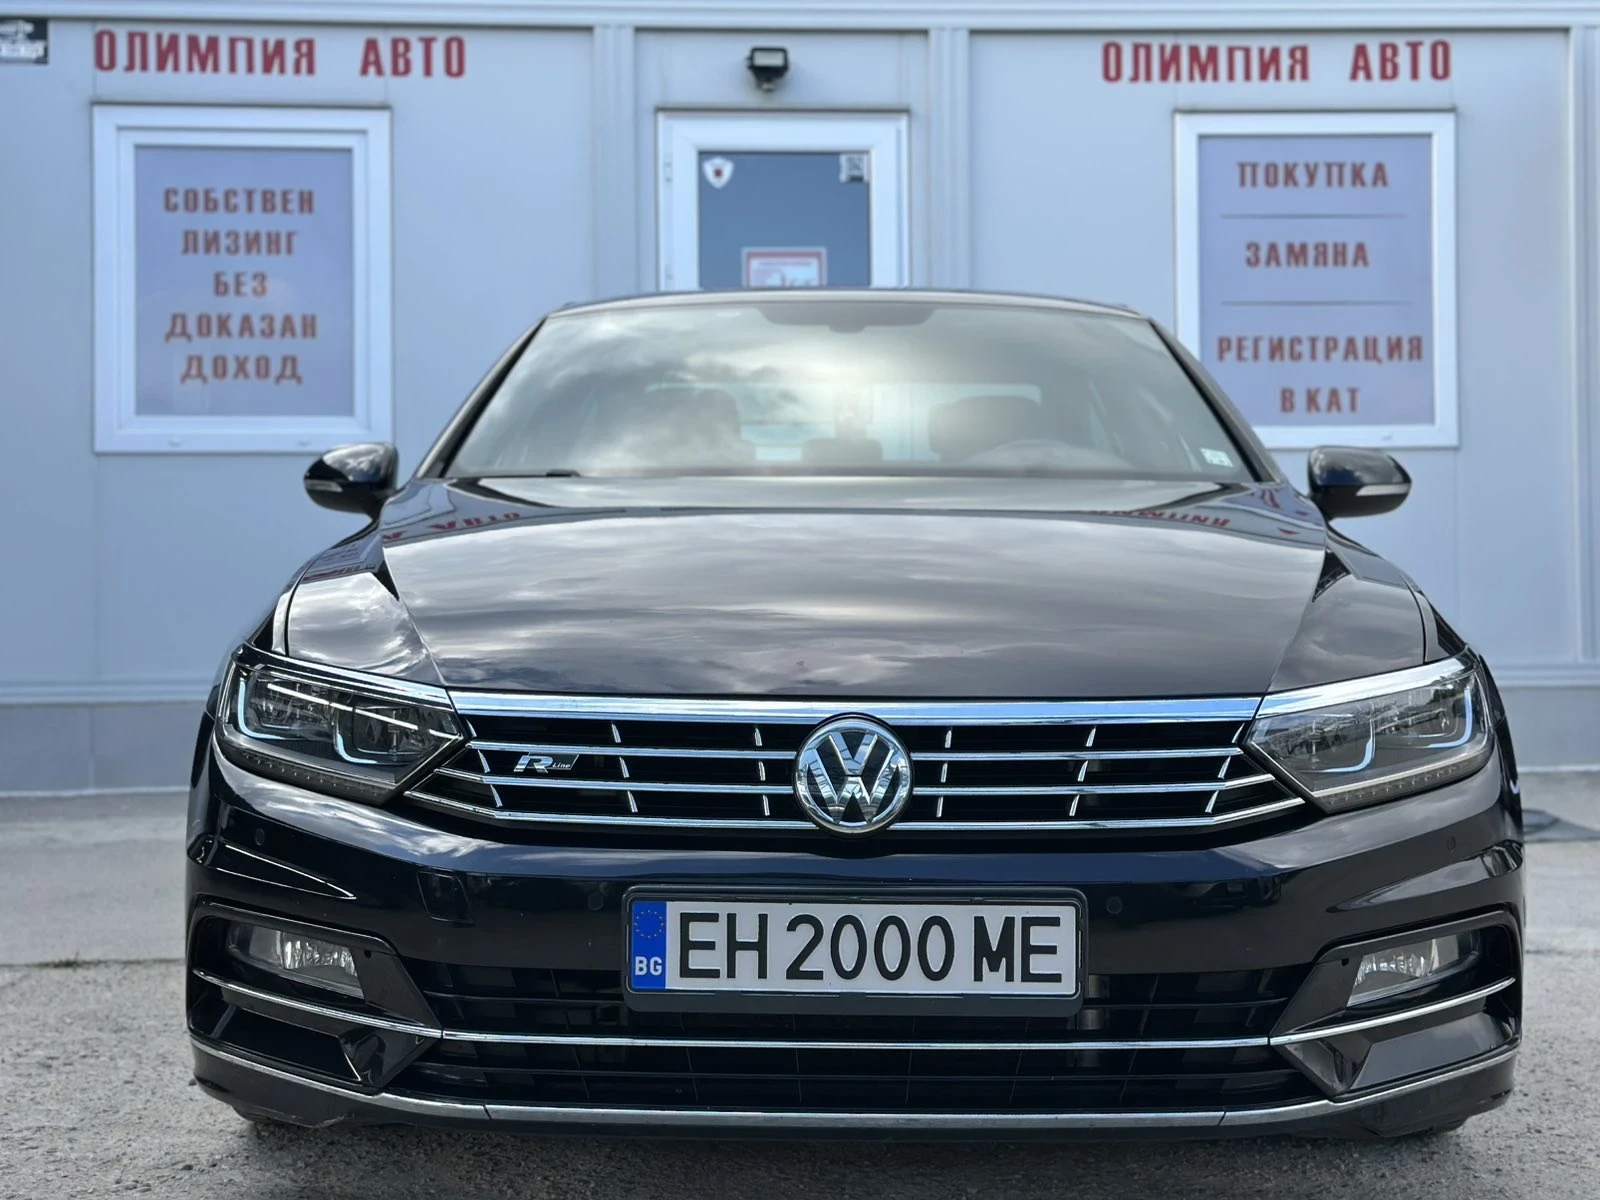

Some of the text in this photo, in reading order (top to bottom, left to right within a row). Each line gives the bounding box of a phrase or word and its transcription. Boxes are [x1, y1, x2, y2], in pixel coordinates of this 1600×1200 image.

[95, 30, 316, 75] ОЛИМПИЯ
[360, 36, 466, 79] АВТО
[1103, 40, 1451, 83] ОЛИМПИЯ АВТО
[1238, 162, 1389, 189] ПОКУПКА
[163, 187, 315, 215] СОБСТВЕН
[182, 229, 297, 257] ЛИЗИНГ
[1246, 242, 1369, 269] ЗАМЯНА
[213, 271, 270, 298] БЕЗ
[164, 312, 318, 342] ДОКАЗАН
[1217, 336, 1424, 365] РЕГИСТРАЦИЯ
[180, 354, 303, 384] ДОХОД
[1280, 387, 1360, 414] В КАТ
[796, 718, 910, 833] VW
[635, 912, 1063, 983] BG EH 2000 ME
